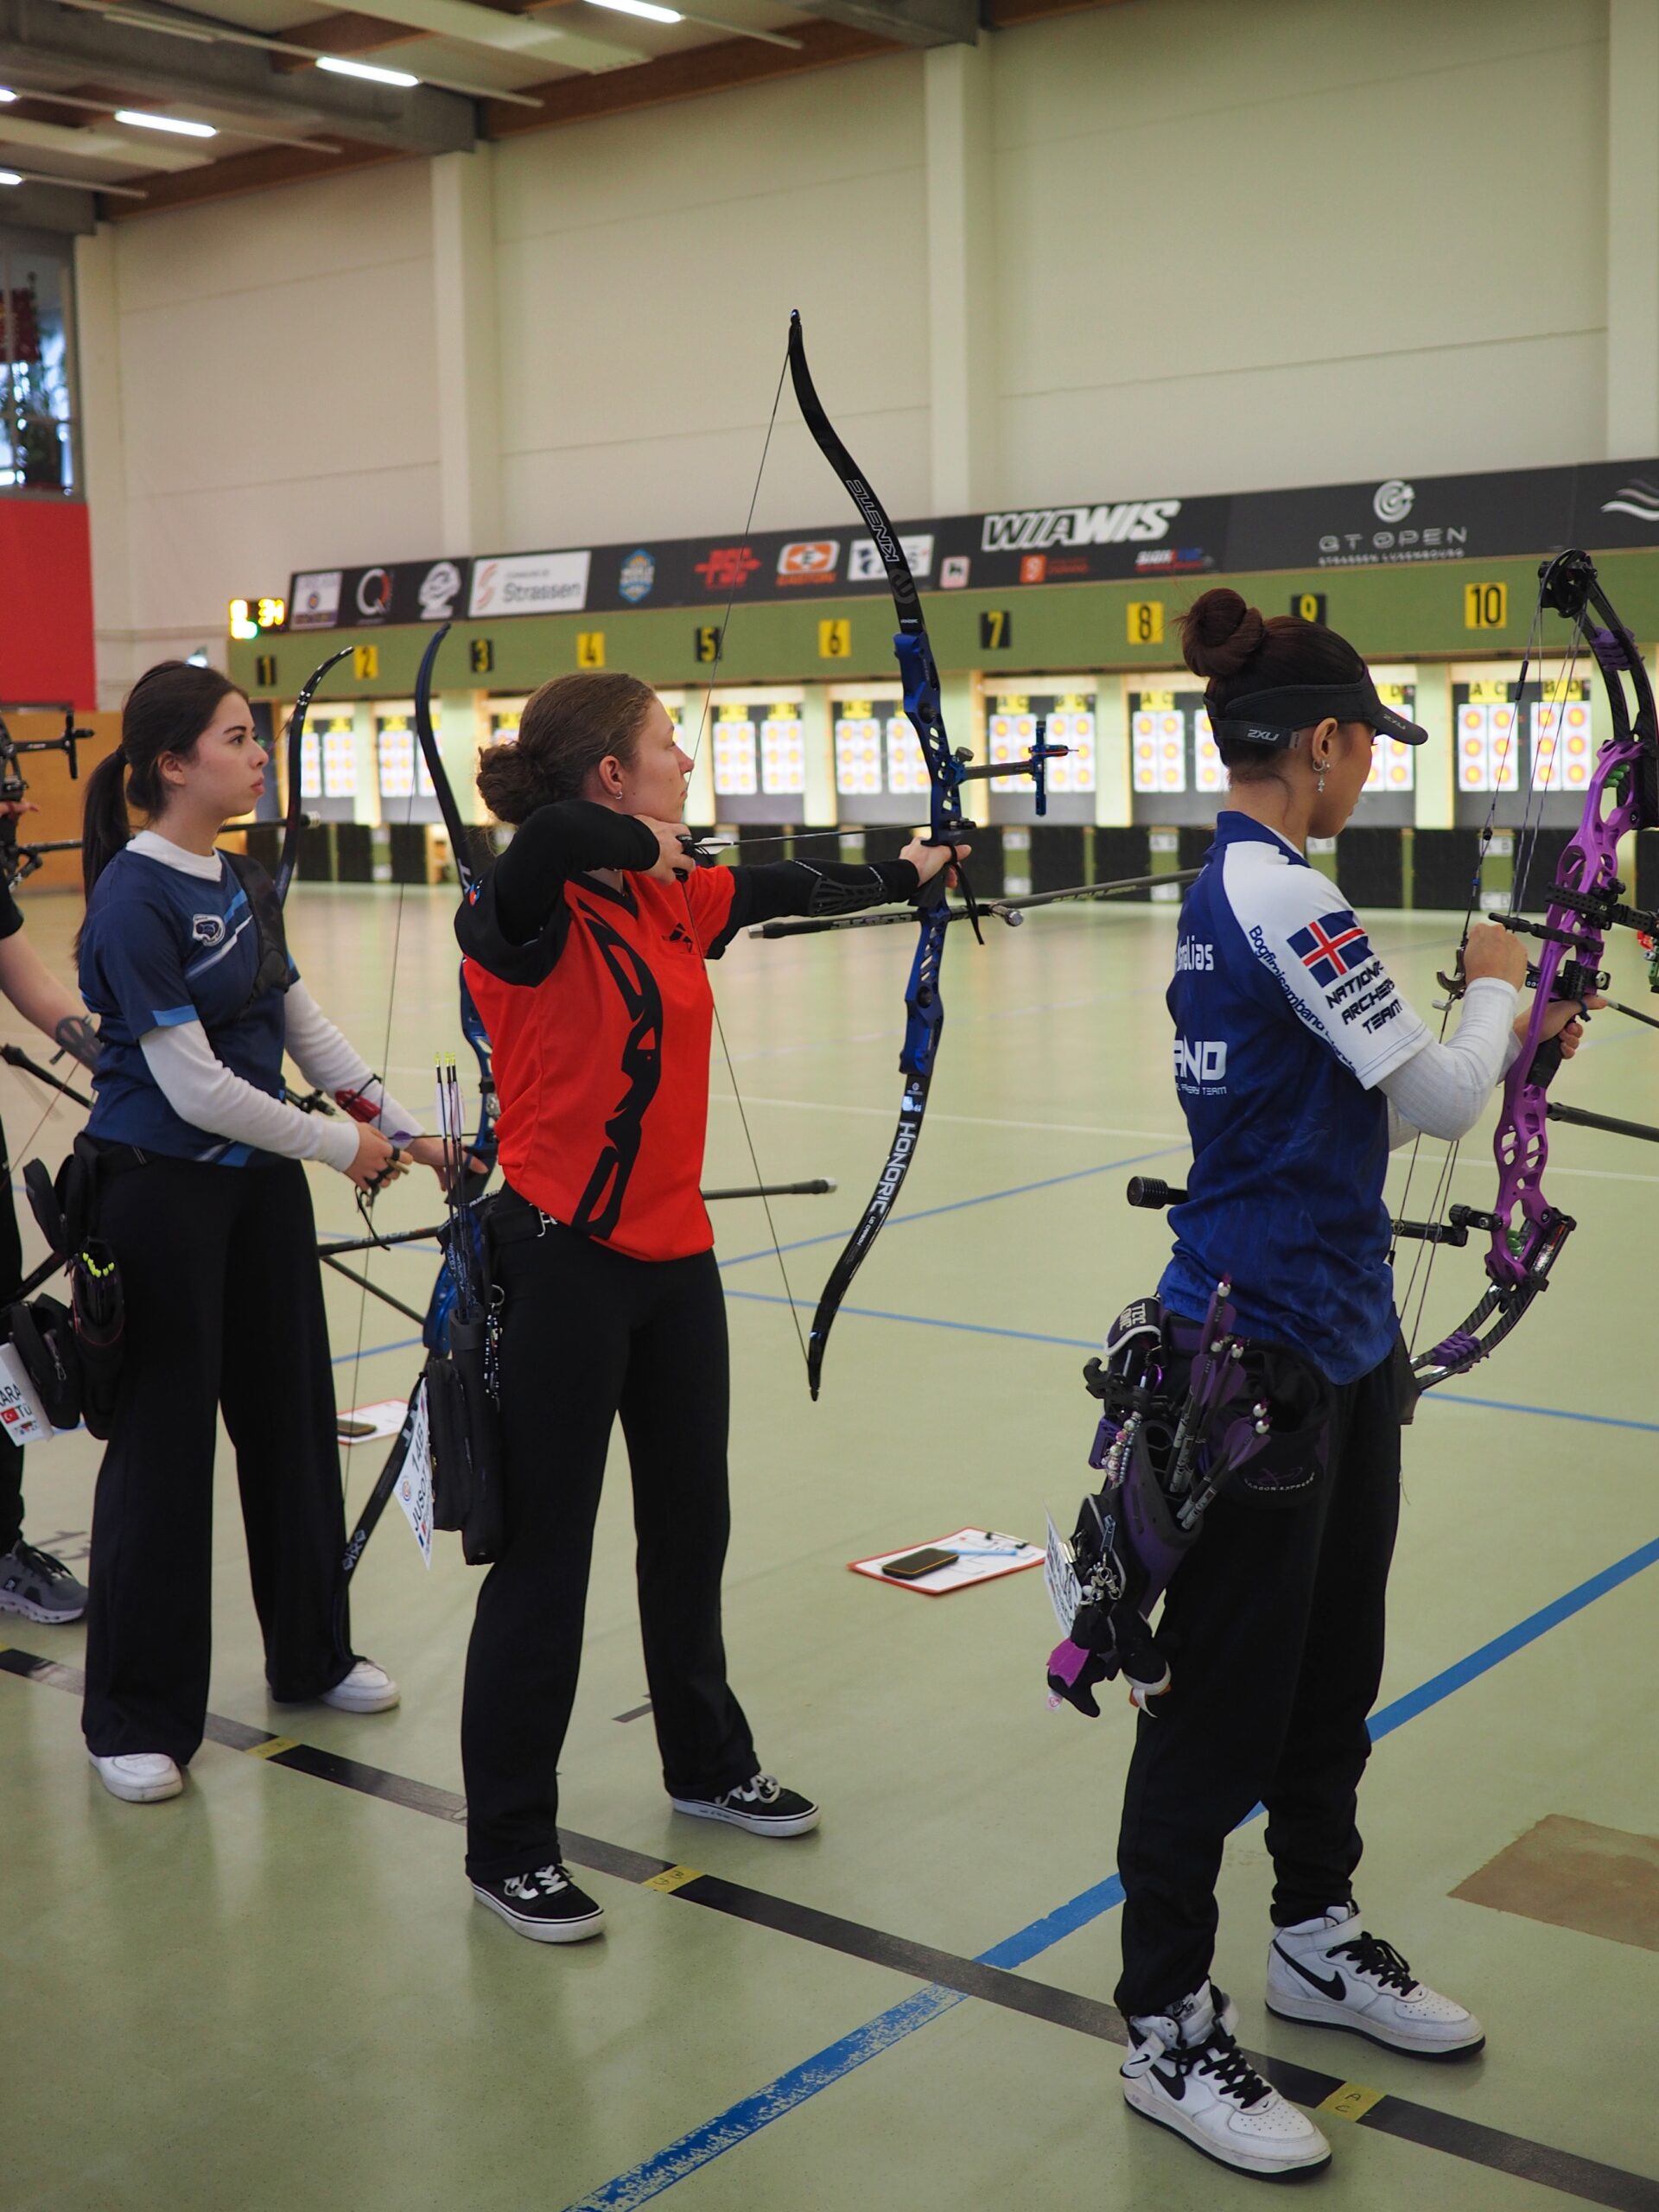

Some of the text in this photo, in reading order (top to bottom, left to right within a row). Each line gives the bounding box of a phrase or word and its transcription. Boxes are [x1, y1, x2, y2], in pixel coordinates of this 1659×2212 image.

[845, 479, 900, 563] KINETIC
[982, 499, 1182, 552] WIAWIS
[1319, 525, 1468, 553] GT OPEN
[502, 582, 582, 604] Strassen
[1299, 594, 1318, 622] 9
[1472, 583, 1502, 627] 10
[829, 621, 842, 655] 6
[987, 611, 1004, 650] 7
[1138, 605, 1153, 641] 8
[473, 640, 489, 672] 3
[584, 638, 598, 664] 4
[701, 627, 717, 662] 5
[263, 656, 272, 686] 1
[359, 647, 373, 677] 2
[1247, 728, 1280, 742] 2XU
[1362, 999, 1403, 1034] TEAM
[1202, 1085, 1228, 1096] TEAM
[870, 1122, 917, 1215] HONORIC
[1345, 2092, 1362, 2102] A
